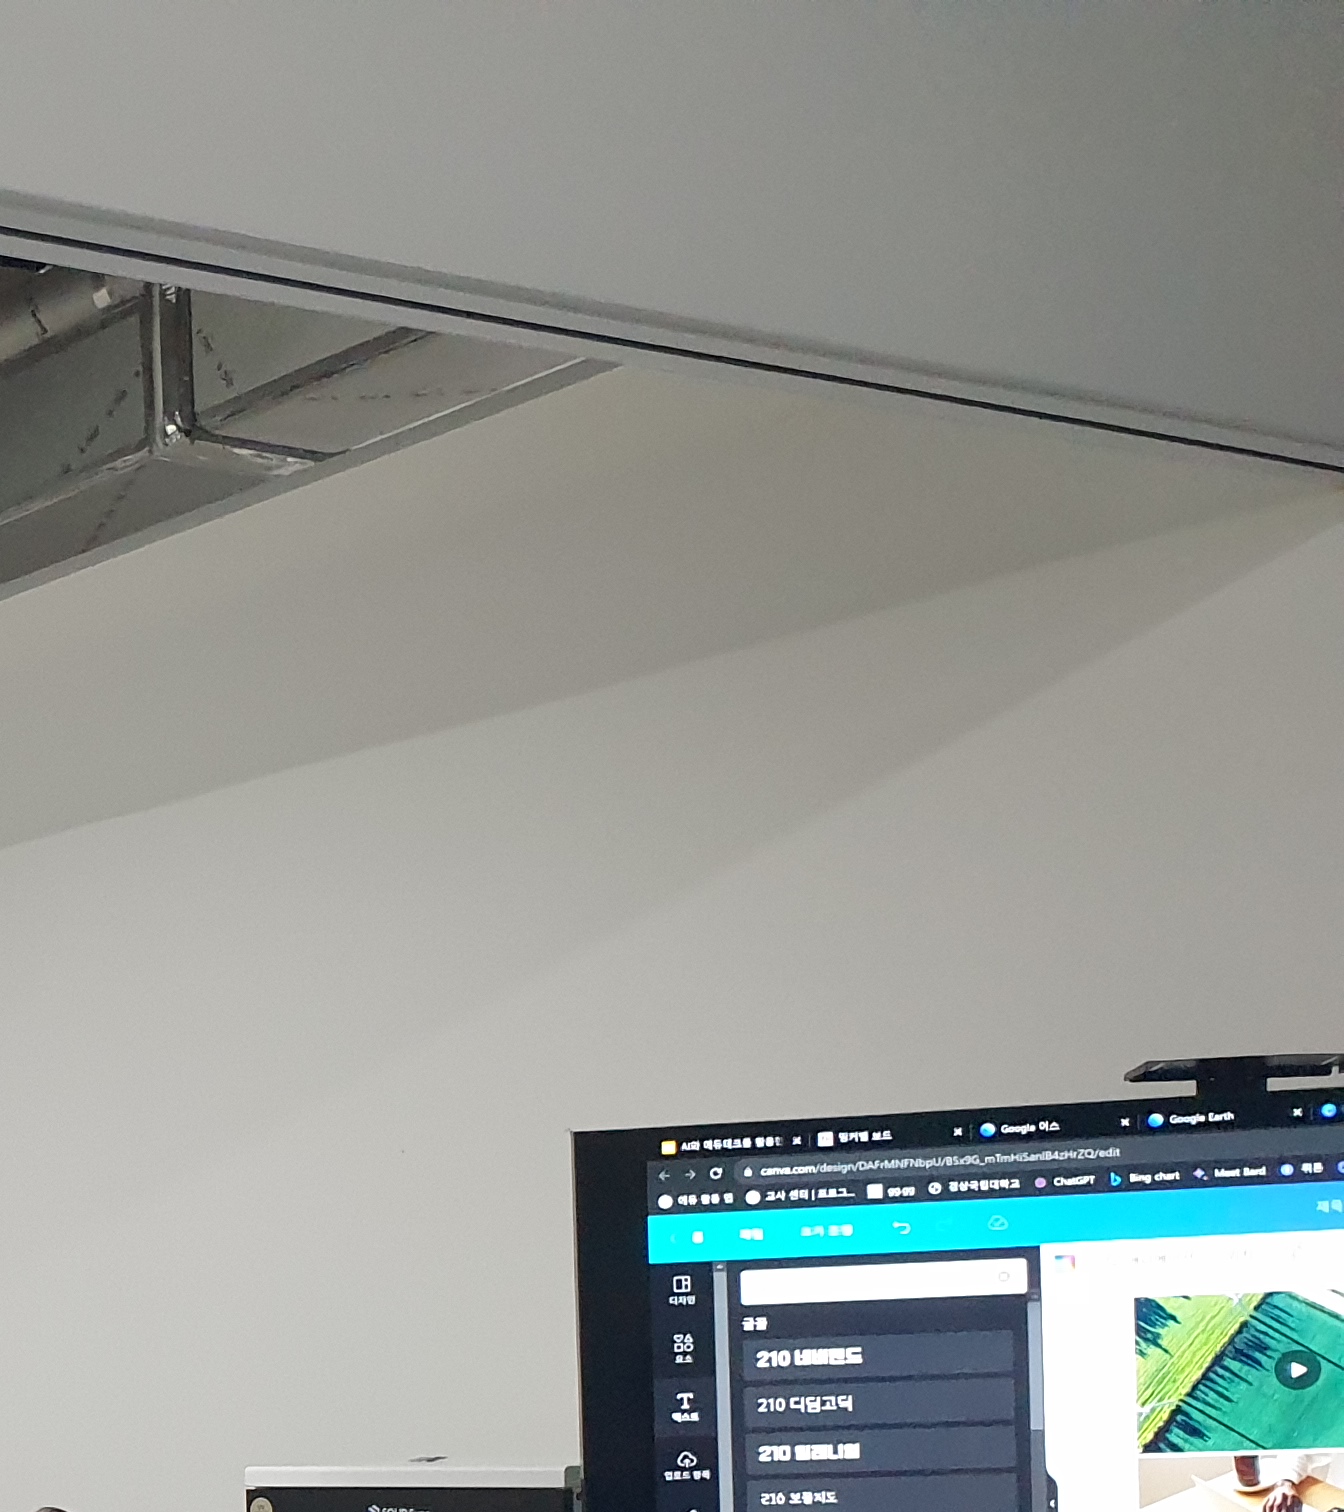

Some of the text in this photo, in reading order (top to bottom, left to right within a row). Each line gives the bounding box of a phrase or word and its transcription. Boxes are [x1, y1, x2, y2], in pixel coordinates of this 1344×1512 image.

[1169, 1113, 1206, 1125] Google
[1000, 1121, 1060, 1135] Google 어스
[1053, 1175, 1096, 1186] ChatGPT
[669, 1295, 695, 1306] 디자인
[756, 1350, 791, 1368] 210
[757, 1394, 853, 1413] 210 디딤고딕
[758, 1445, 791, 1462] 210
[760, 1492, 786, 1505] 210
